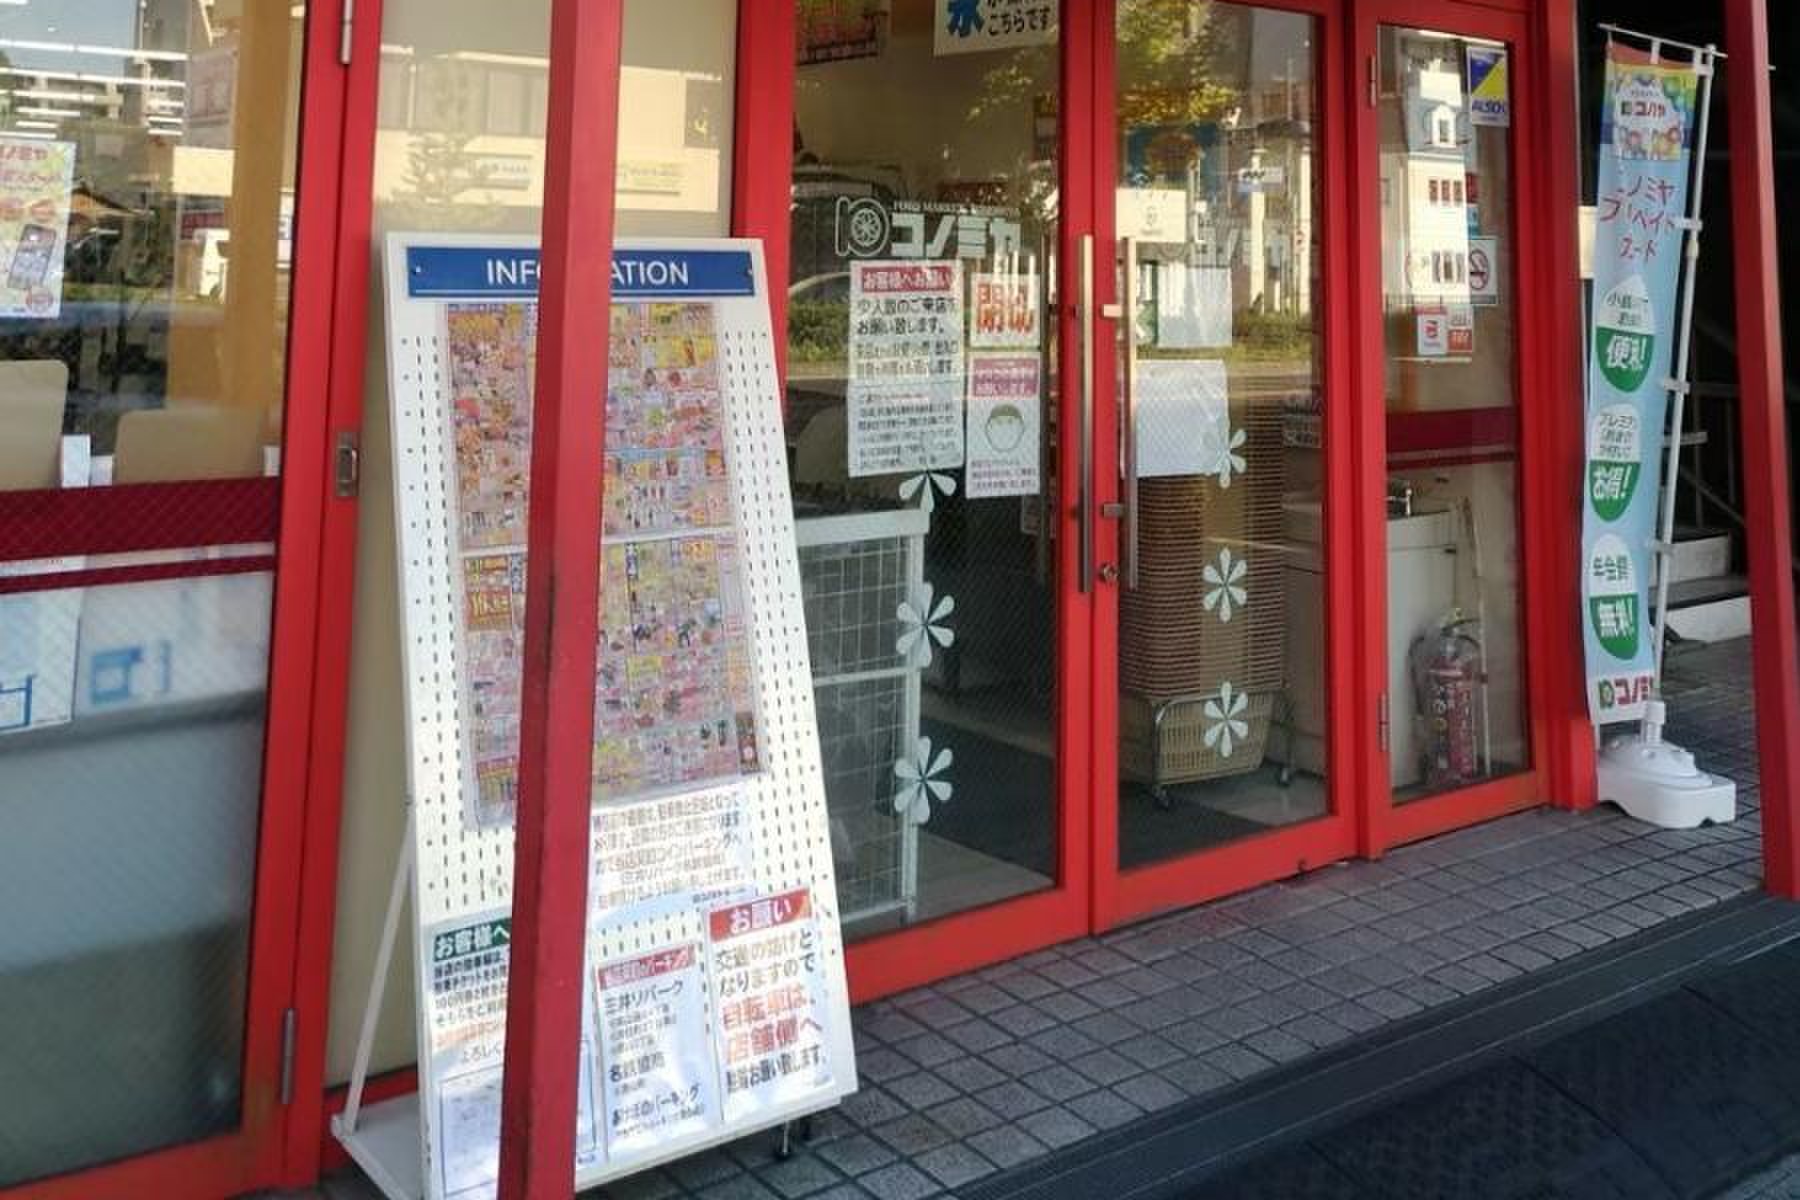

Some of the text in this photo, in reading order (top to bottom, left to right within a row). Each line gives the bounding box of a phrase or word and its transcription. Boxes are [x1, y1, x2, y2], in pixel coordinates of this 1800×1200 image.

[988, 6, 1050, 36] こちらです
[486, 259, 689, 286] INFATION
[729, 896, 792, 936] お願い
[436, 924, 511, 960] お客様へ
[719, 951, 815, 998] なりますので
